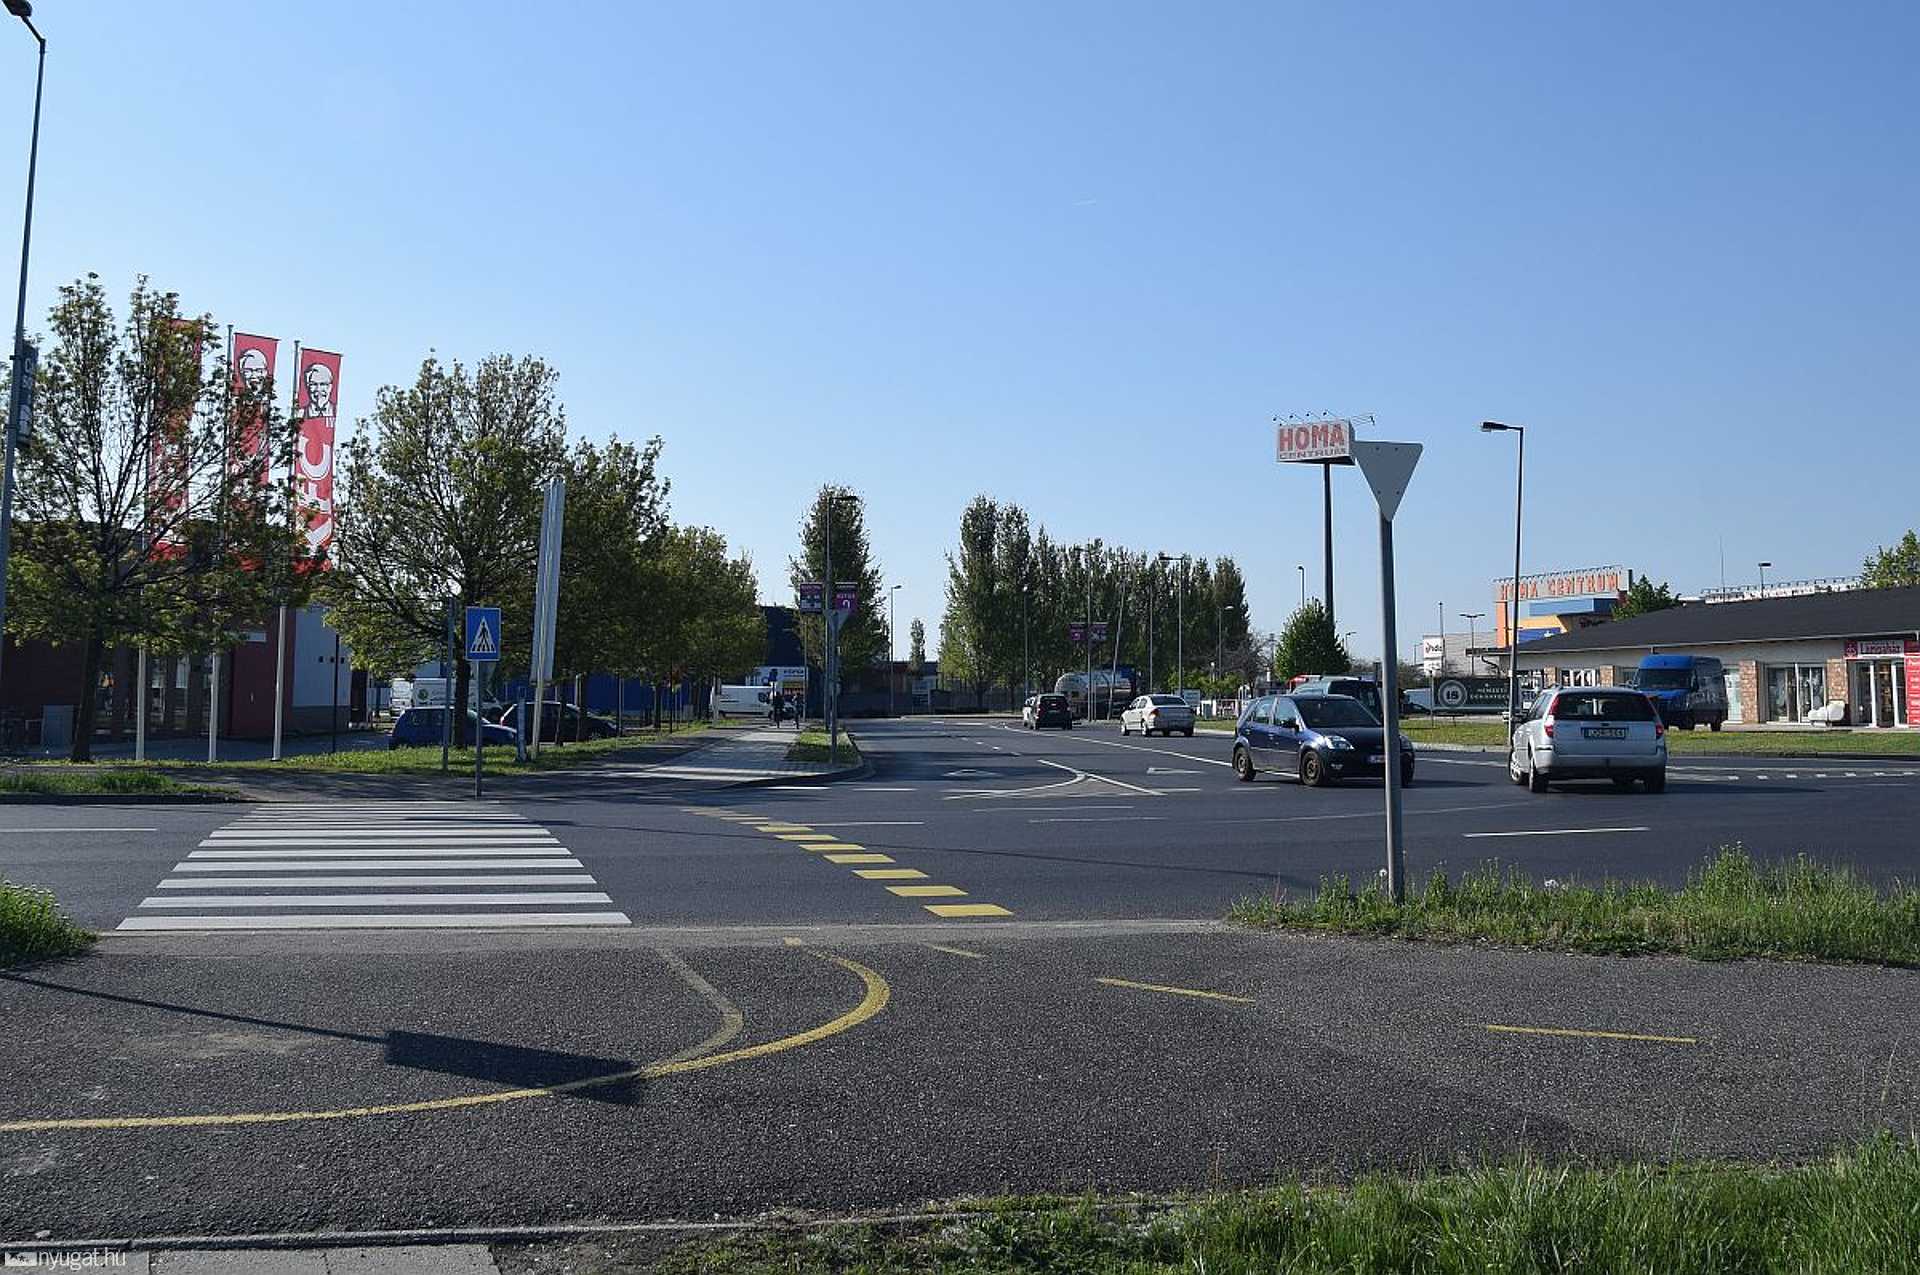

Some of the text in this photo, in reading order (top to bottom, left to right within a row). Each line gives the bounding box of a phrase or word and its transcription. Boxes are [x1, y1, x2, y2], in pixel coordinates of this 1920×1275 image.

[1279, 422, 1345, 452] HOMA
[1279, 448, 1346, 460] CENTRUM
[1547, 570, 1618, 597] CENTRUM
